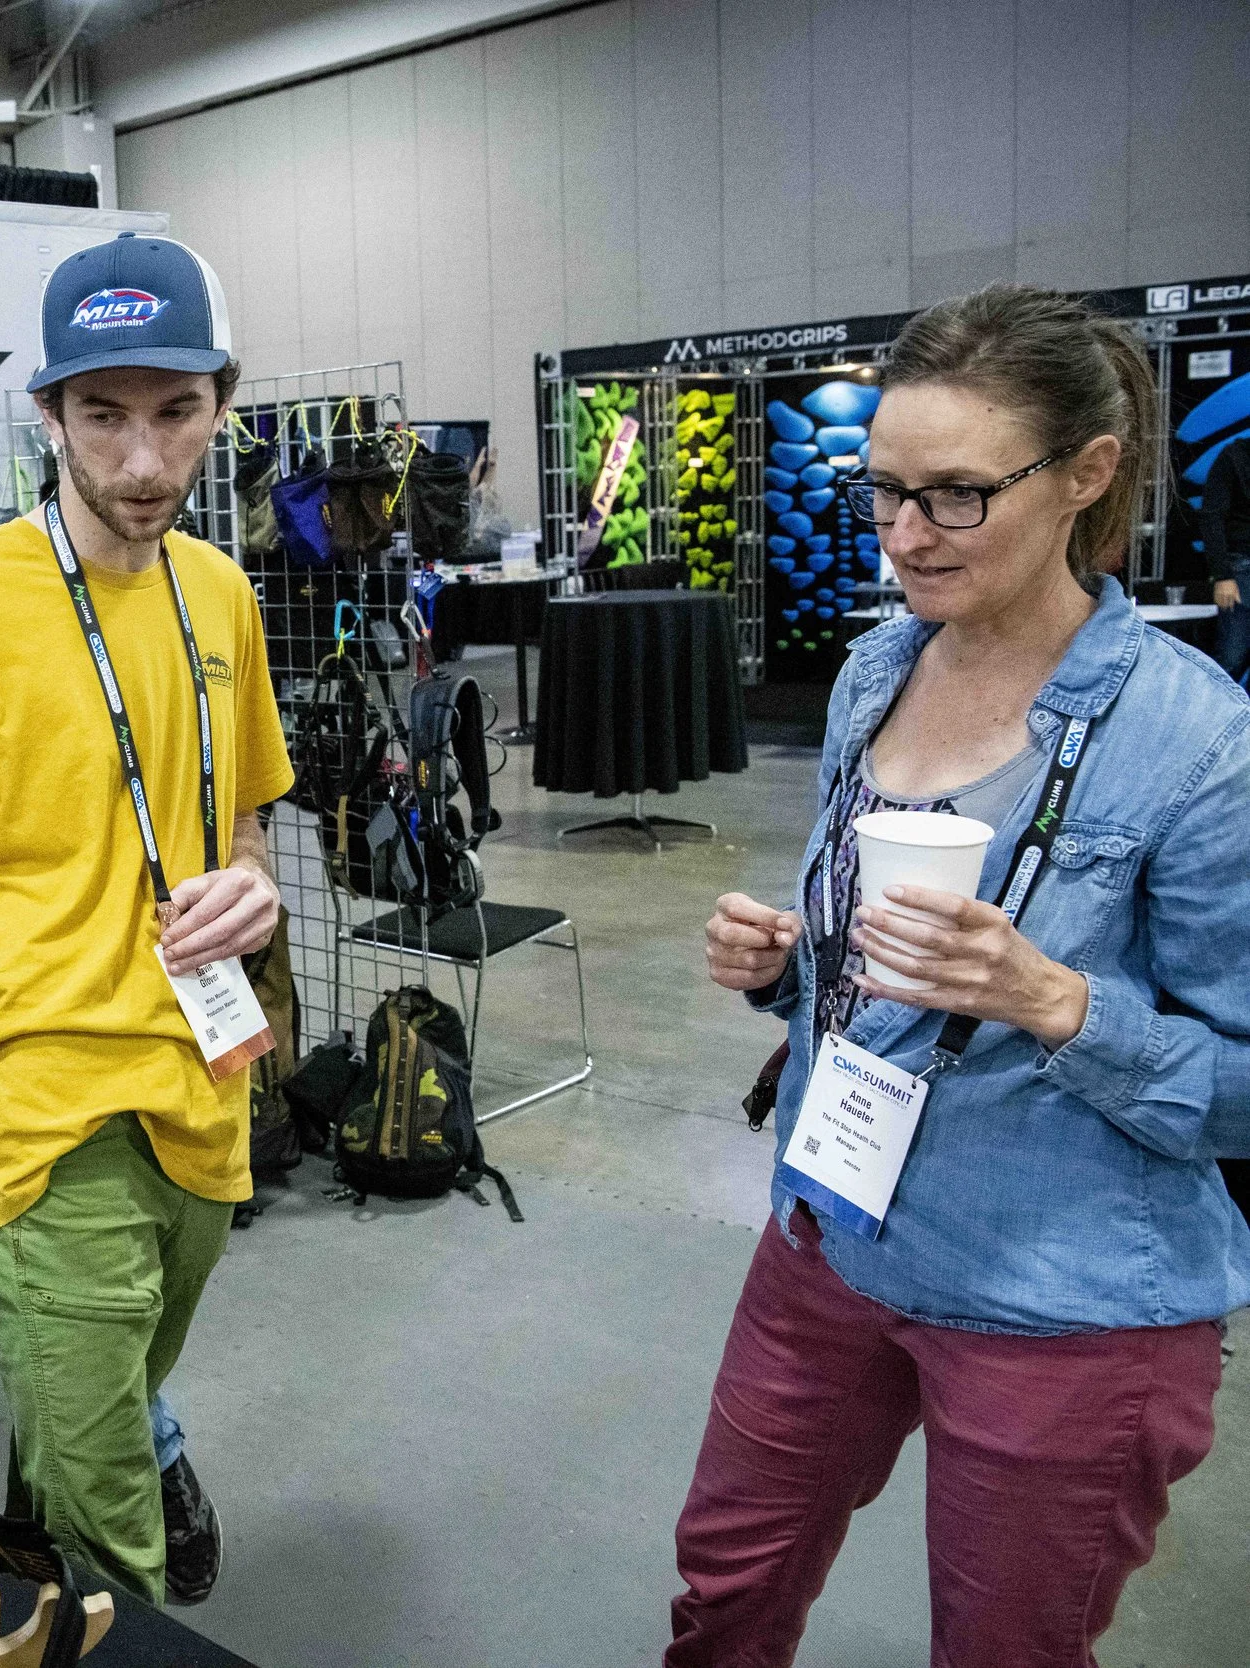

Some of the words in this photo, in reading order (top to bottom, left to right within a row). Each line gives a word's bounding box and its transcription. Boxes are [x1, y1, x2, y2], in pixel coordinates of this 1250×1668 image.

[71, 300, 170, 326] MISTY
[92, 319, 143, 330] Mountain
[706, 324, 848, 355] METHODGRIPS
[48, 503, 59, 530] CWA
[90, 634, 105, 663] CWA
[203, 662, 232, 680] MIST
[1060, 731, 1083, 766] CWA
[132, 779, 144, 810] CWA
[1005, 868, 1026, 909] CLIMBING
[1021, 849, 1036, 871] WALL
[1014, 851, 1041, 907] ASSOCIATION
[195, 964, 213, 977] Gavin
[199, 973, 219, 988] Glover
[833, 1055, 862, 1079] CWA
[862, 1071, 914, 1105] SUMMIT
[840, 1099, 874, 1125] Haueter
[849, 1090, 872, 1109] Anne
[822, 1112, 832, 1122] The
[832, 1118, 840, 1128] Fit
[840, 1123, 852, 1134] Stop
[853, 1128, 869, 1144] Health
[870, 1140, 882, 1152] Club
[835, 1135, 858, 1153] Manager
